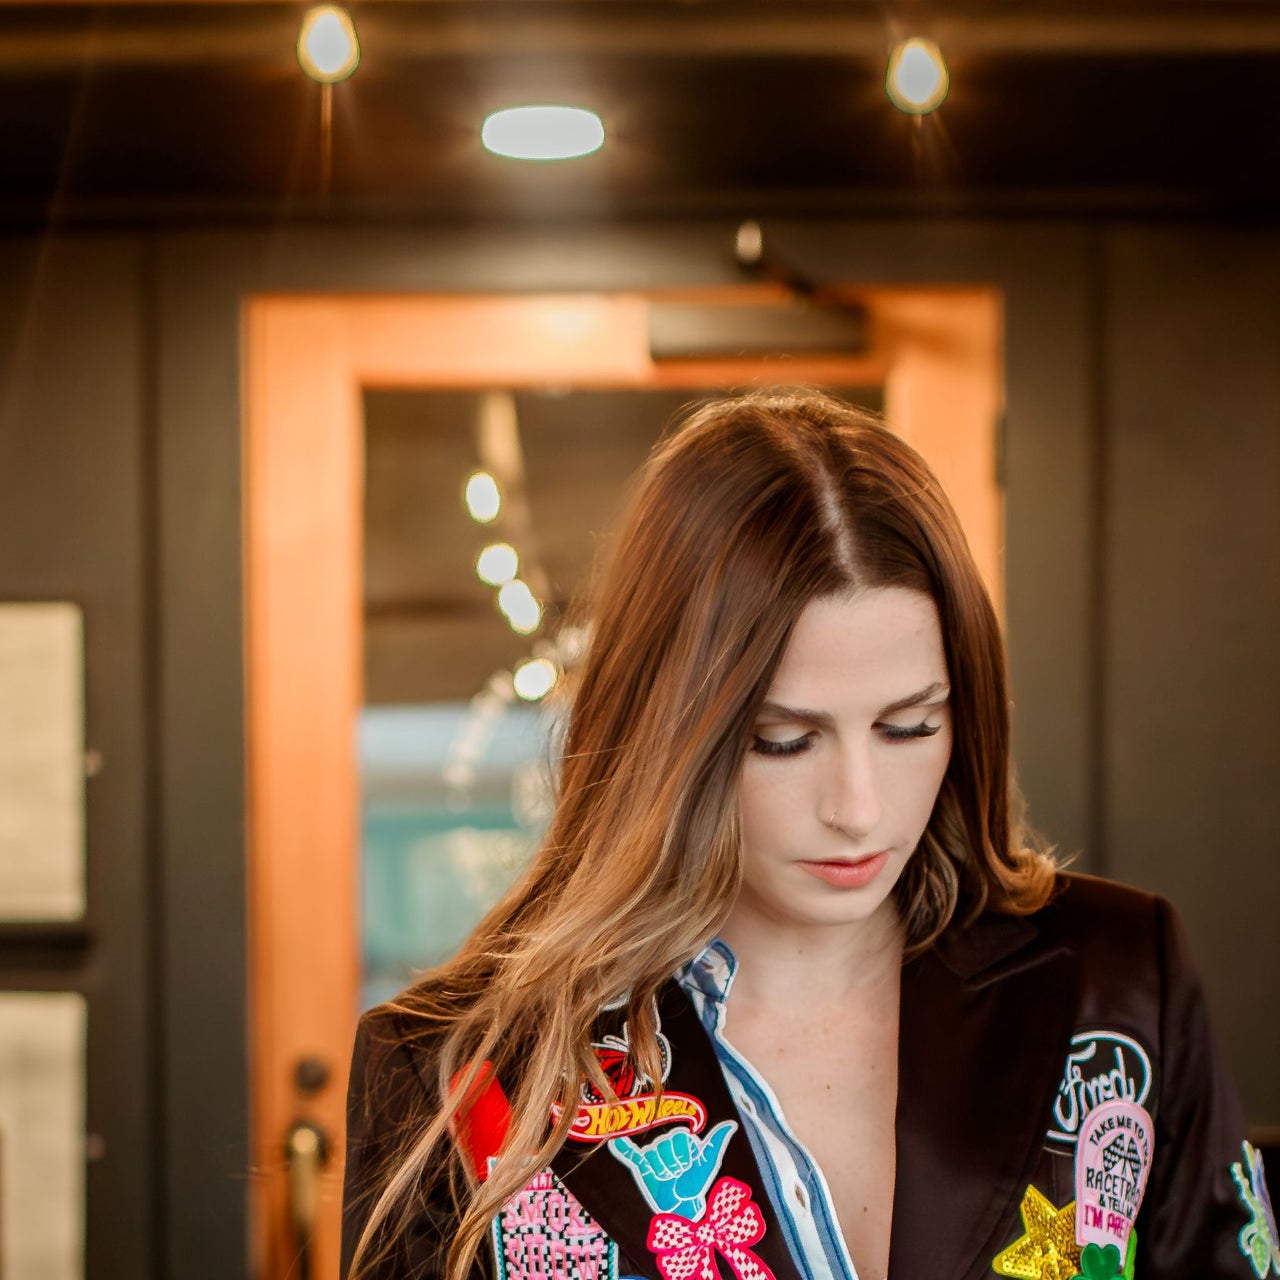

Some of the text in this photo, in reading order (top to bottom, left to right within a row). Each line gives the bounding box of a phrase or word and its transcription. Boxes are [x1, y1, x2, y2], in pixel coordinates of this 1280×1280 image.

[1089, 1117, 1116, 1146] TAKE
[1116, 1115, 1133, 1129] ME
[1134, 1121, 1144, 1140] TO
[1084, 1204, 1103, 1230] I'M
[1108, 1196, 1125, 1217] TELL
